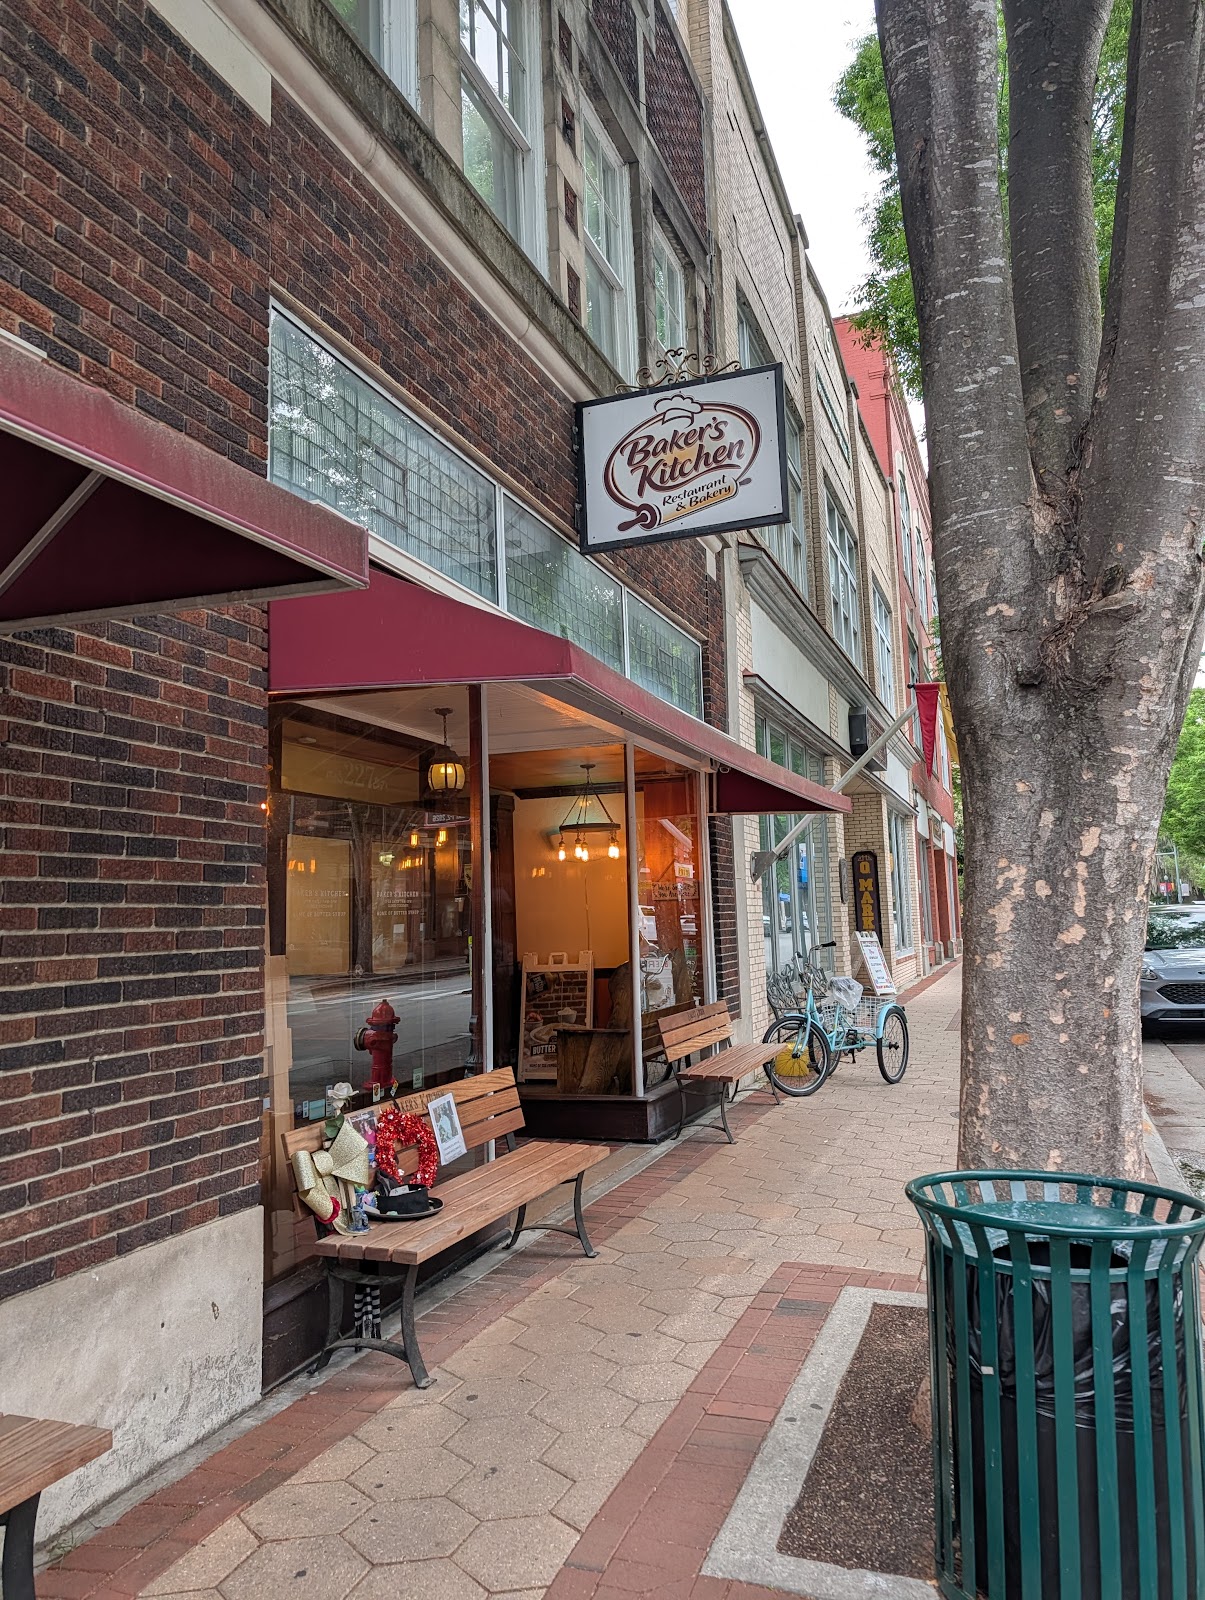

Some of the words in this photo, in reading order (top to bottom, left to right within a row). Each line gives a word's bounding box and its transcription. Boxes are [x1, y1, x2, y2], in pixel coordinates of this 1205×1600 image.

[620, 416, 729, 467] Baker's
[630, 439, 745, 498] Kitchen
[662, 474, 727, 506] Restaurant
[675, 501, 687, 512] &
[689, 485, 732, 508] Bakery
[532, 1044, 557, 1055] BUTTER
